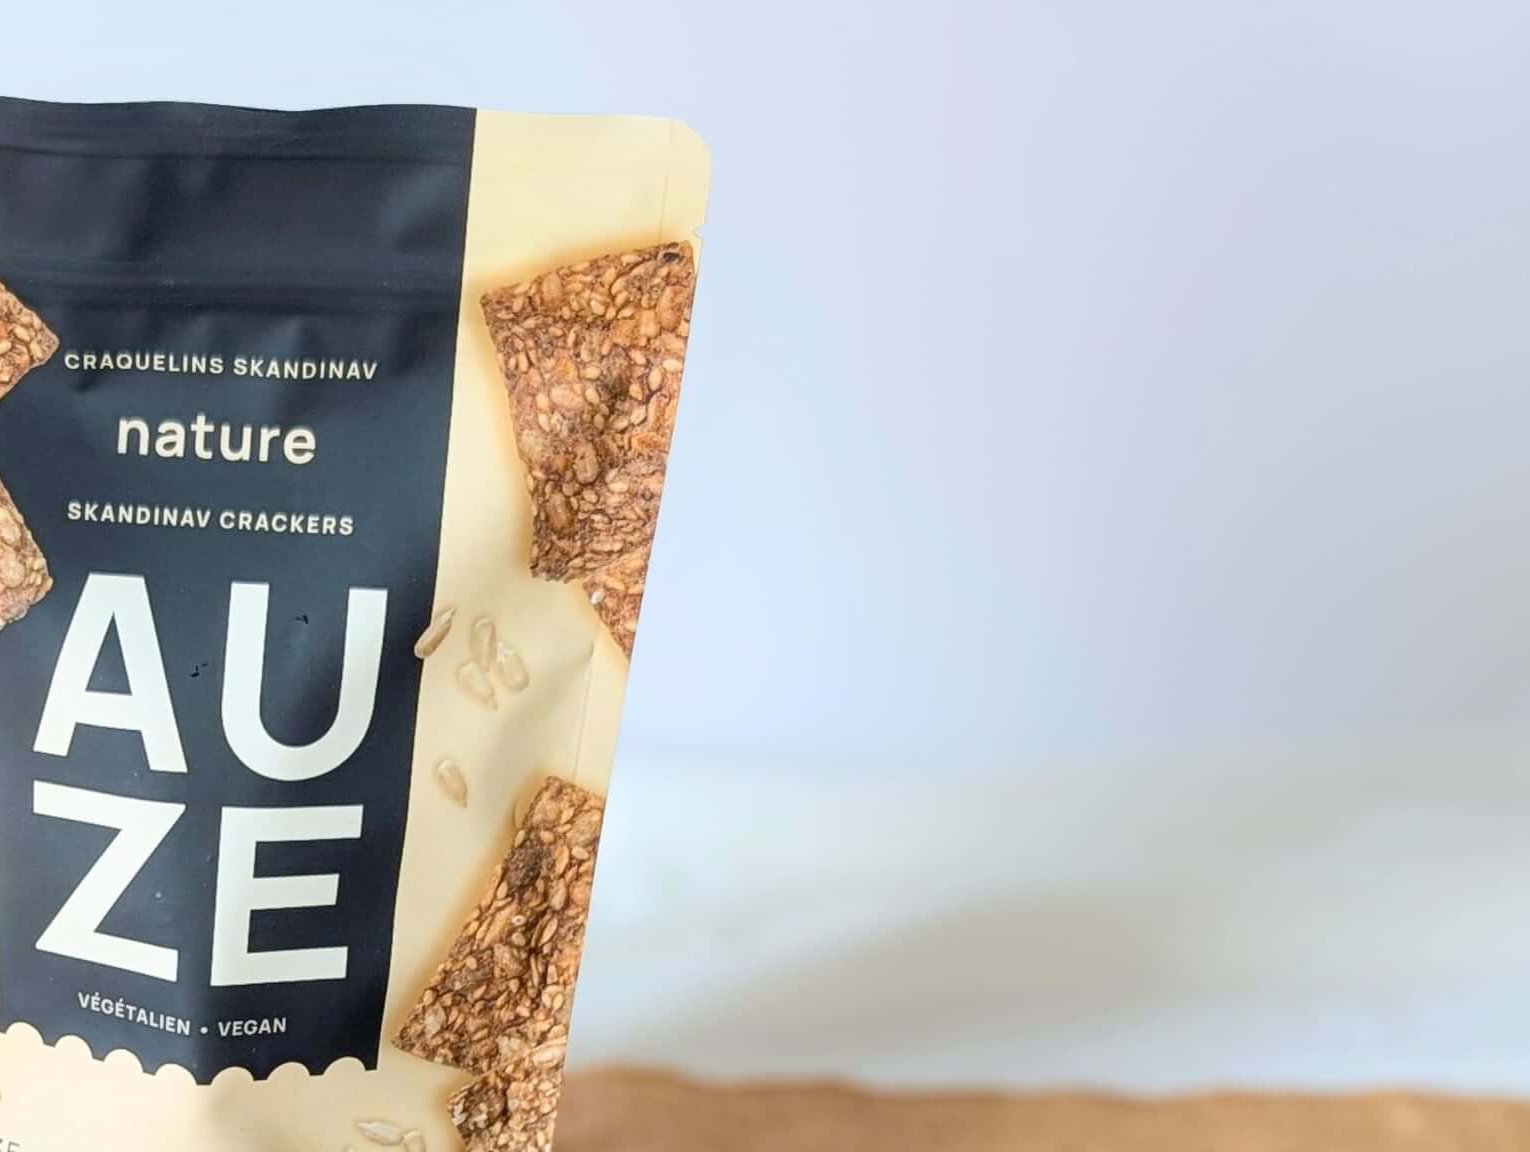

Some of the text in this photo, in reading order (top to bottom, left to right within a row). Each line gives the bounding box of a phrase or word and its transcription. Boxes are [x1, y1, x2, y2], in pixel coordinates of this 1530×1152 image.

[64, 353, 378, 381] CRAQUELINS SKANDINAV
[117, 414, 317, 464] nature
[67, 502, 354, 536] SKANDINAV CRACKERS
[32, 571, 388, 782] AU
[33, 780, 364, 987] ZE
[77, 991, 287, 1037] VÉGÉTALIEN VEGAN
